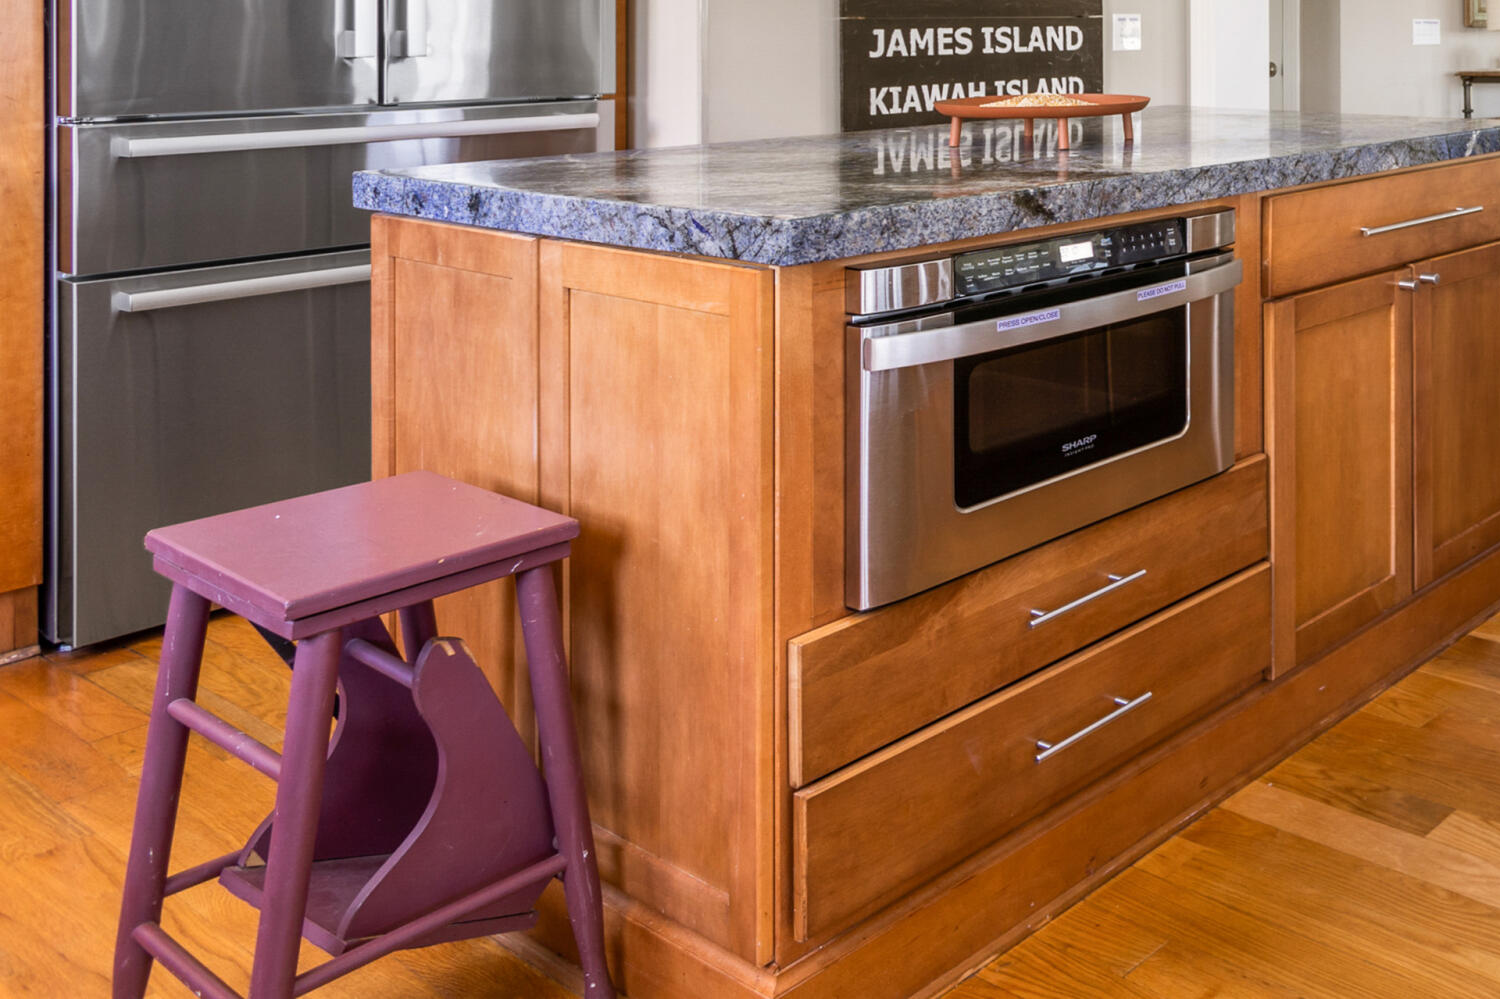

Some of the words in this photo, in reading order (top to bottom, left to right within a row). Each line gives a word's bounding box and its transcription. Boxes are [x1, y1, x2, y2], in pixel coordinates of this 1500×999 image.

[869, 27, 973, 58] JAMES
[981, 26, 1084, 53] ISLAND
[869, 81, 986, 116] KIAWAH
[999, 319, 1020, 329] PRESS
[1062, 434, 1097, 452] SHARP
